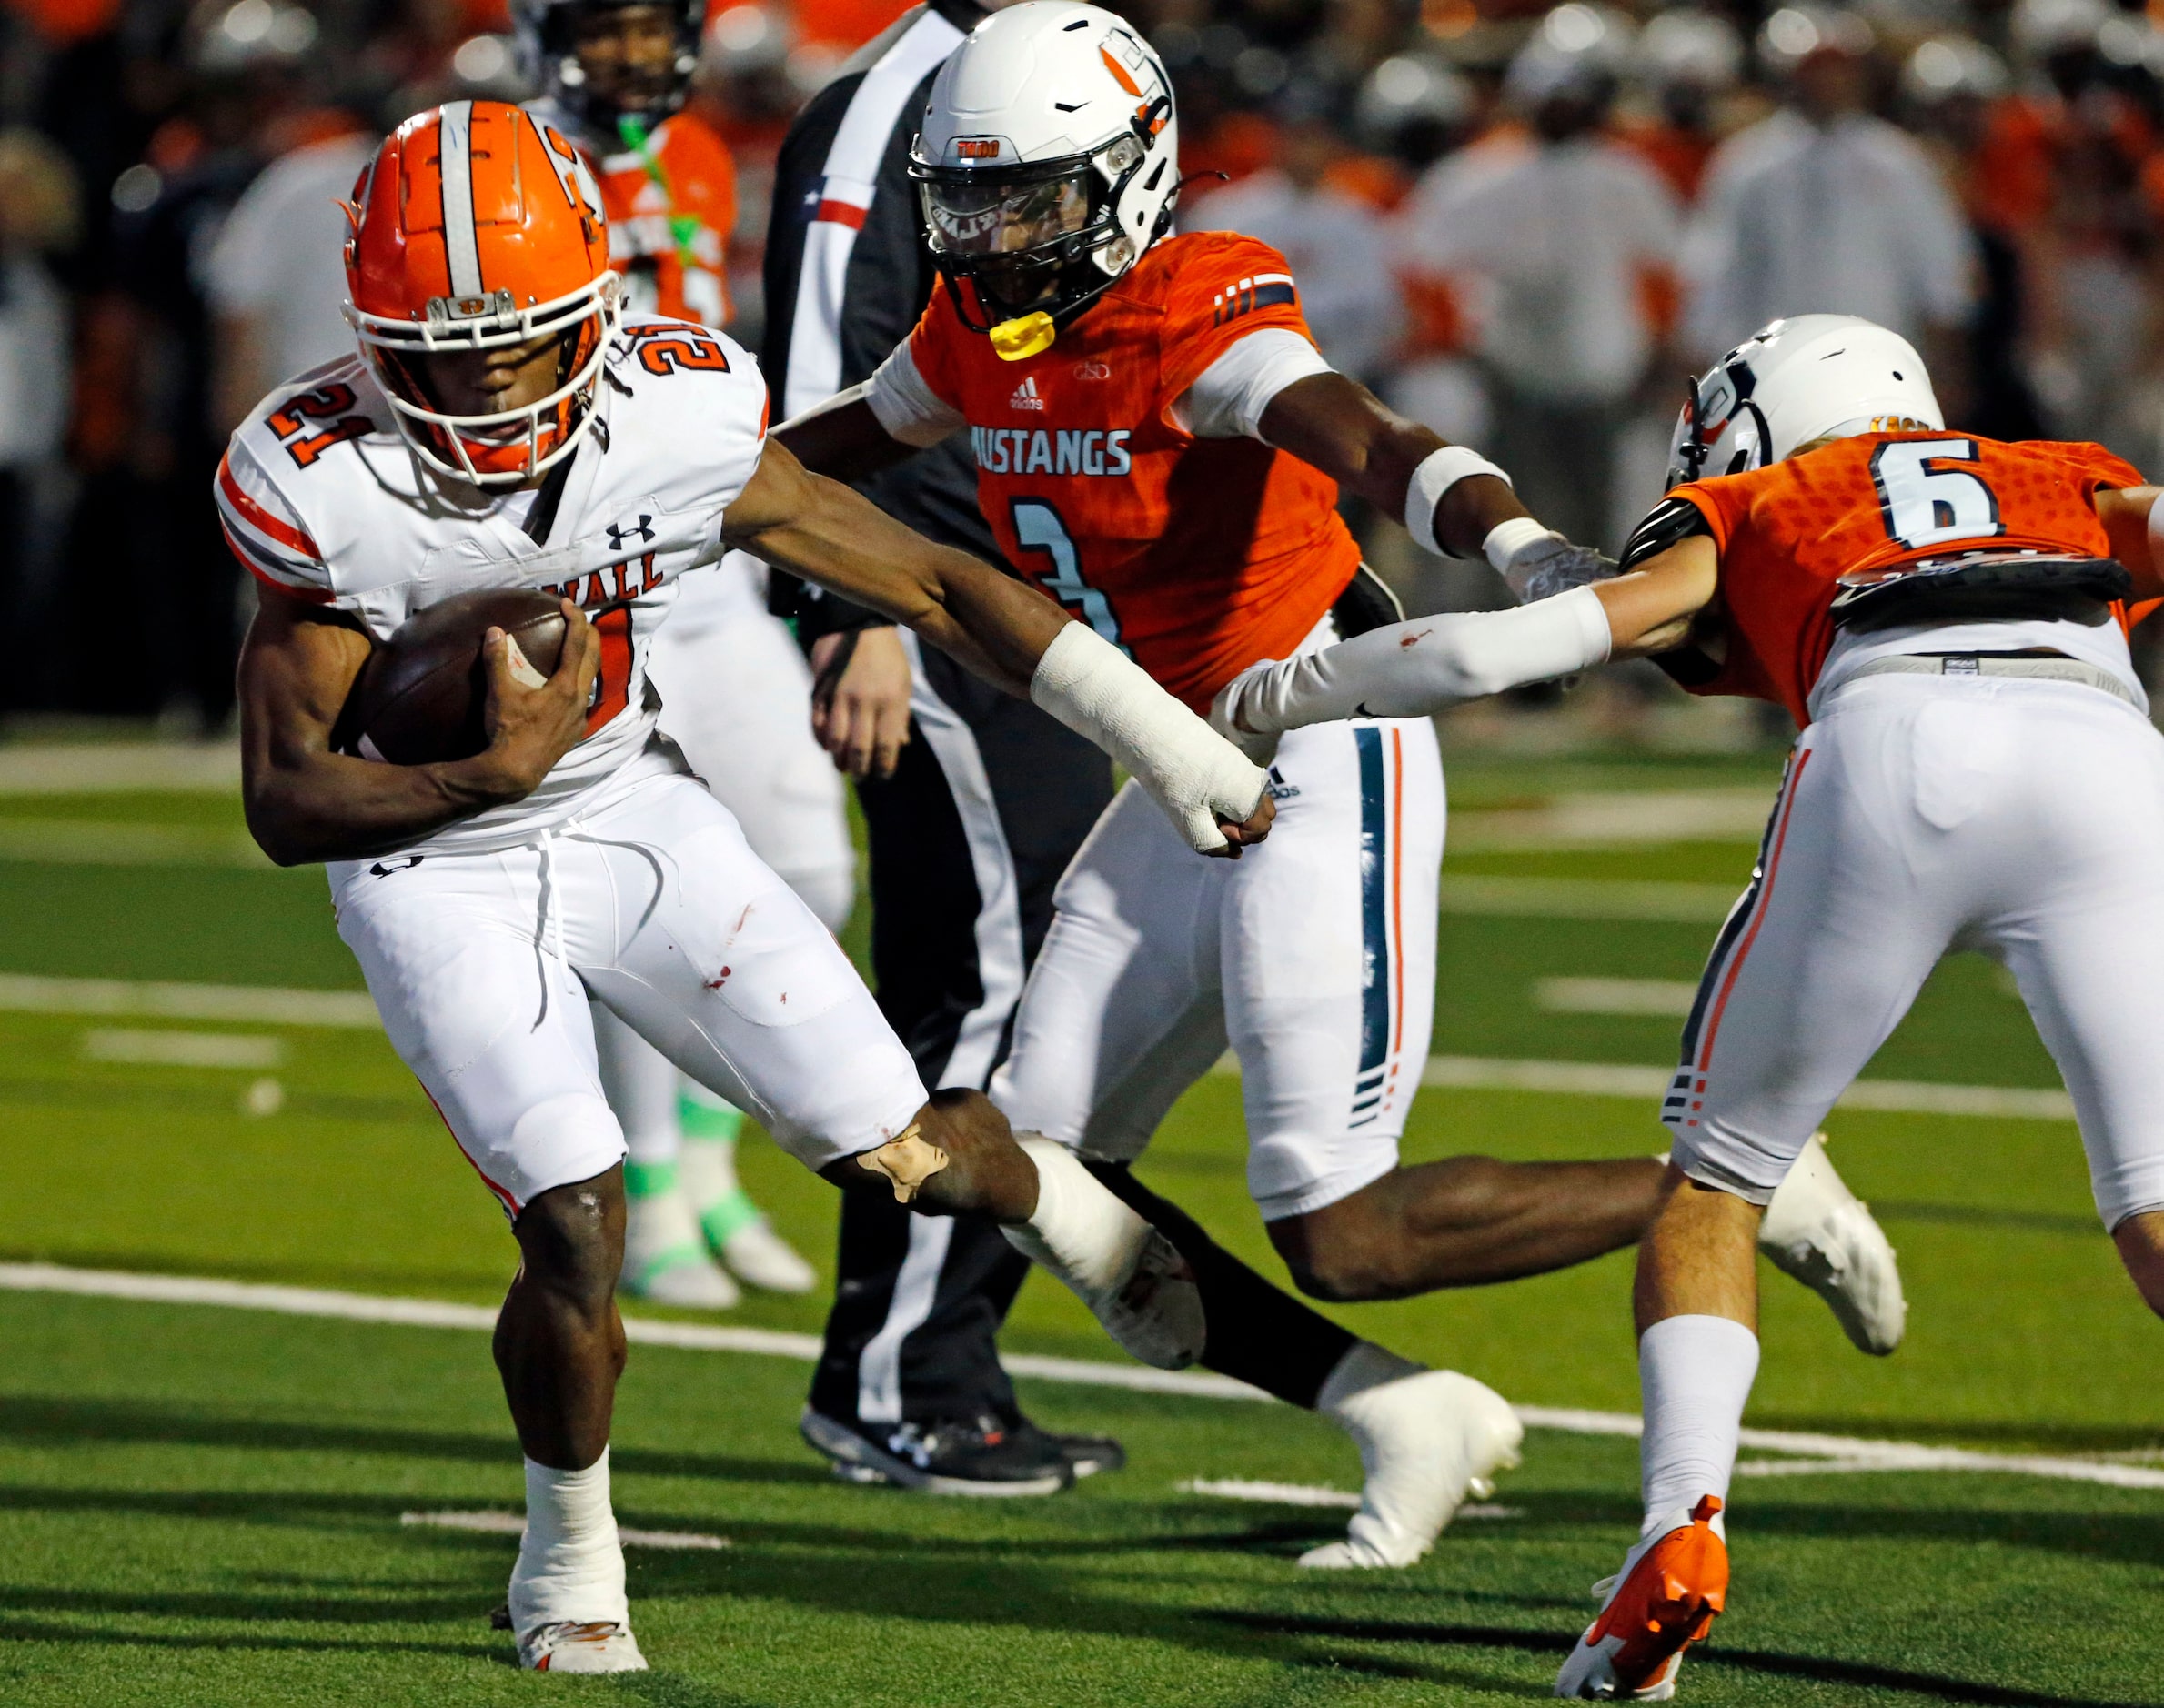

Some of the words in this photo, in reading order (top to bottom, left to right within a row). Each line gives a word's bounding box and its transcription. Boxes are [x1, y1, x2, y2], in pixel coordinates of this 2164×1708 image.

[264, 383, 376, 469] 21
[1868, 438, 2006, 550] 6
[538, 550, 664, 608] WALL
